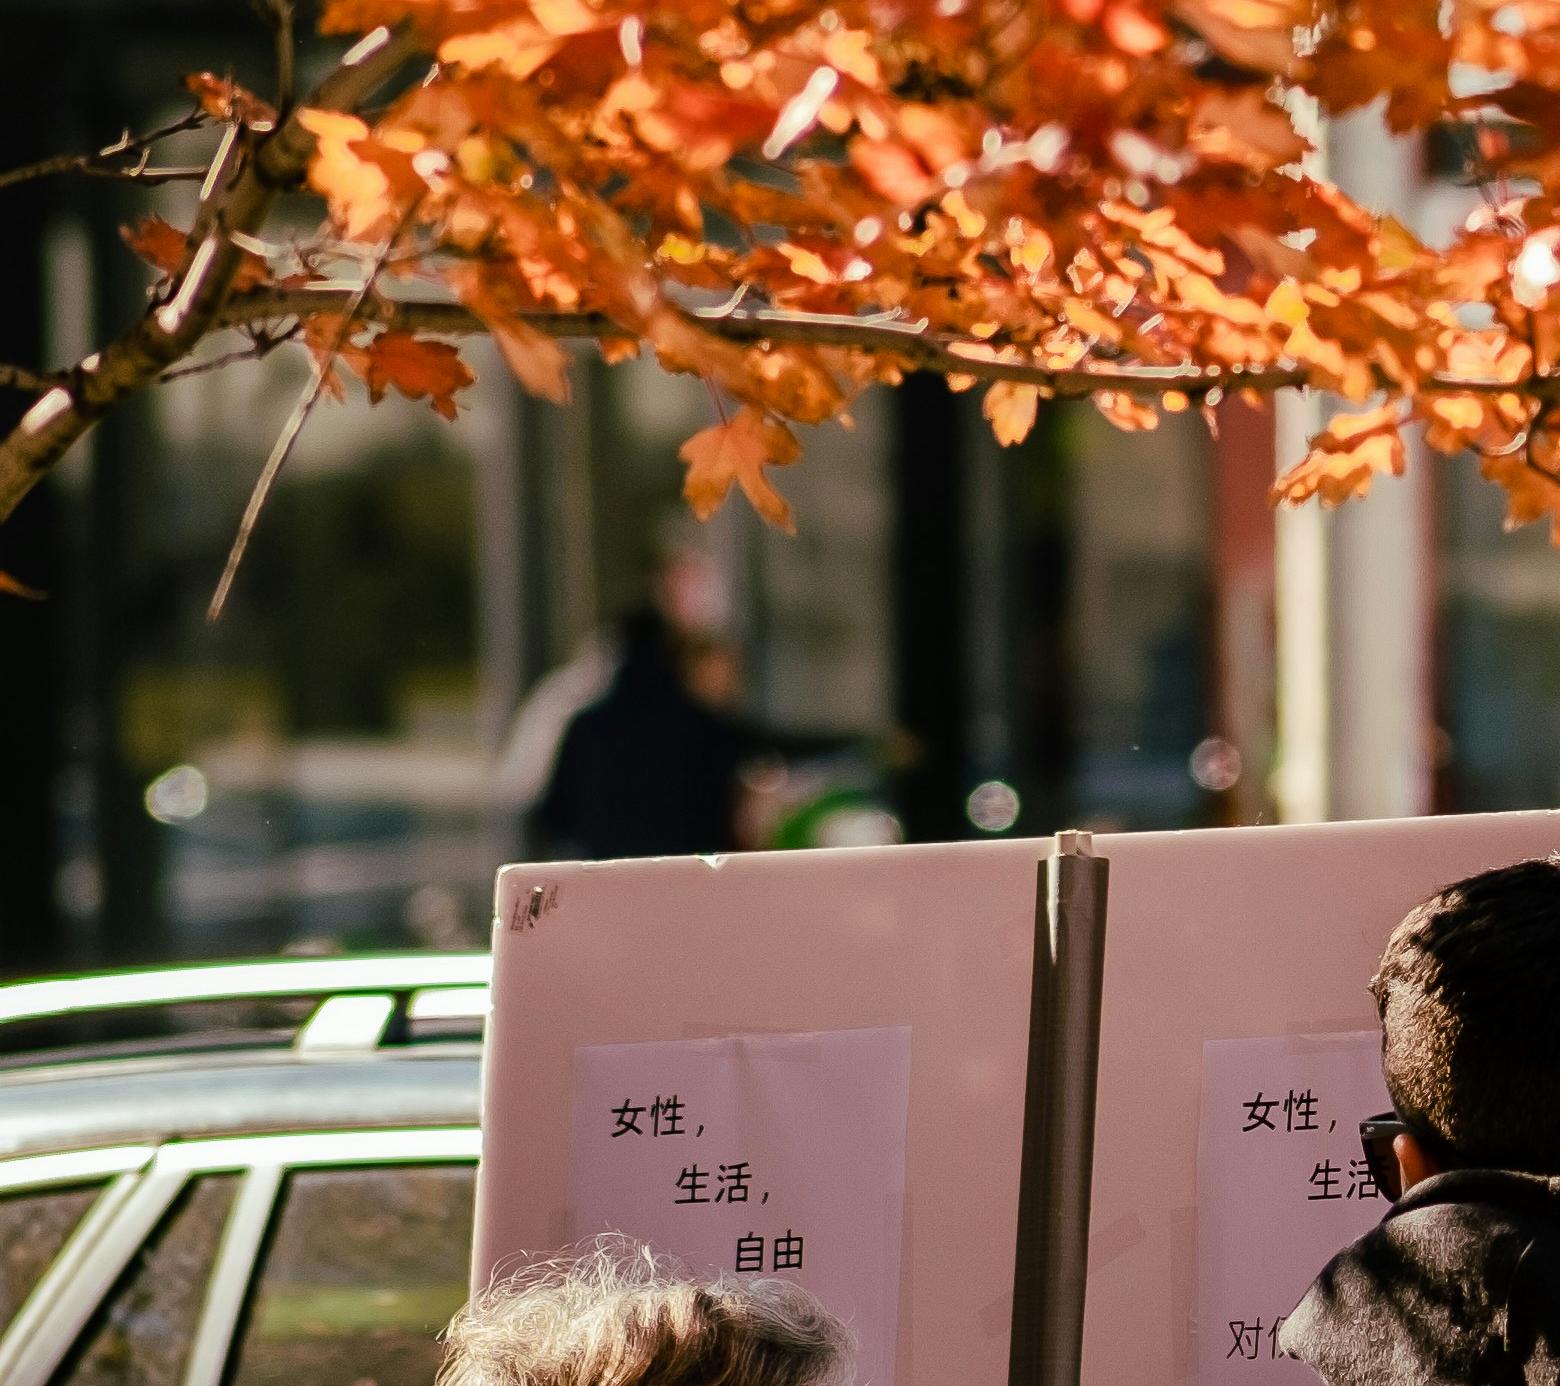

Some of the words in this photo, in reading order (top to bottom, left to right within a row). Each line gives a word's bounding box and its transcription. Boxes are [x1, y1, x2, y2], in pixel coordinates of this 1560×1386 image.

[610, 1093, 706, 1138] 女性，
[1241, 1088, 1337, 1134] 女性，
[672, 1161, 770, 1205] 生活，
[734, 1228, 804, 1273] 自由
